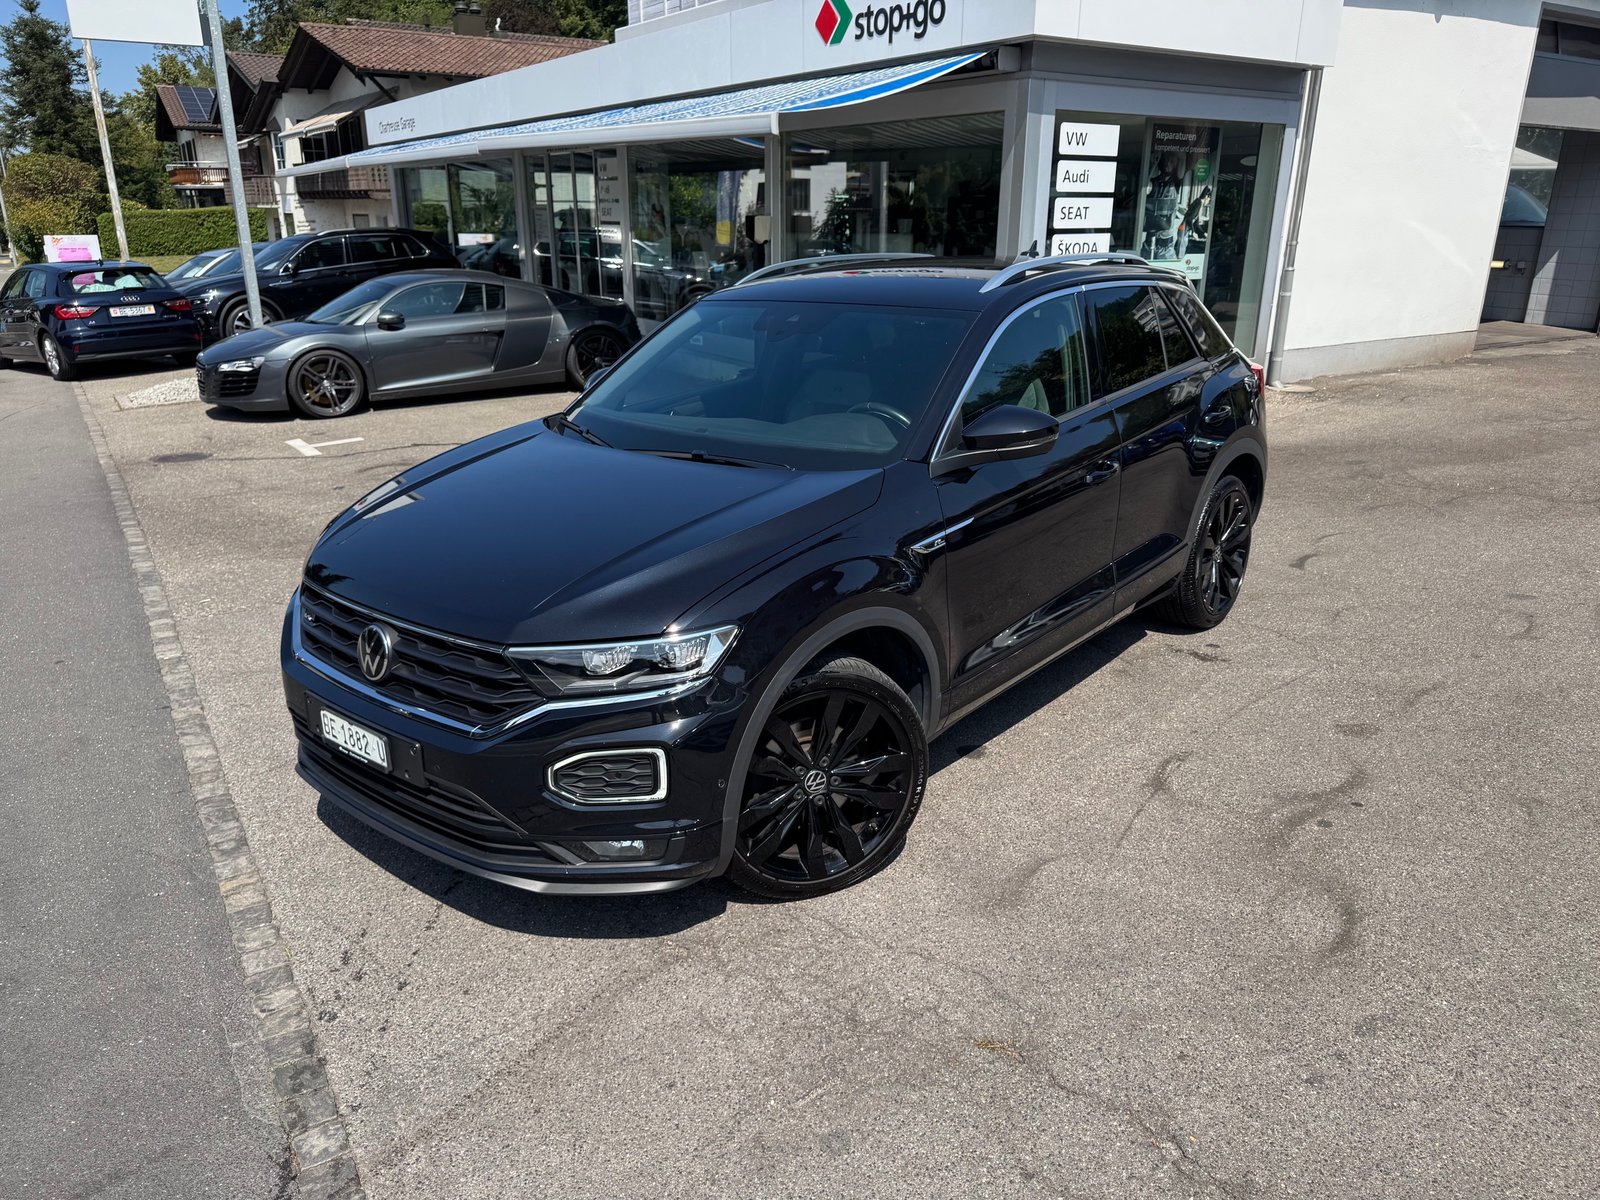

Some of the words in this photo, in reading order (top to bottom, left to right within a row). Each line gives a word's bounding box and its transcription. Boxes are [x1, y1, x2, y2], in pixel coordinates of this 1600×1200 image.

[854, 0, 946, 44] stop+go
[1066, 131, 1088, 146] VW
[1155, 129, 1197, 141] Reparaturen
[1062, 169, 1090, 183] Audi
[1060, 206, 1090, 220] SEAT
[322, 713, 339, 740] BE
[341, 723, 371, 757] 1882
